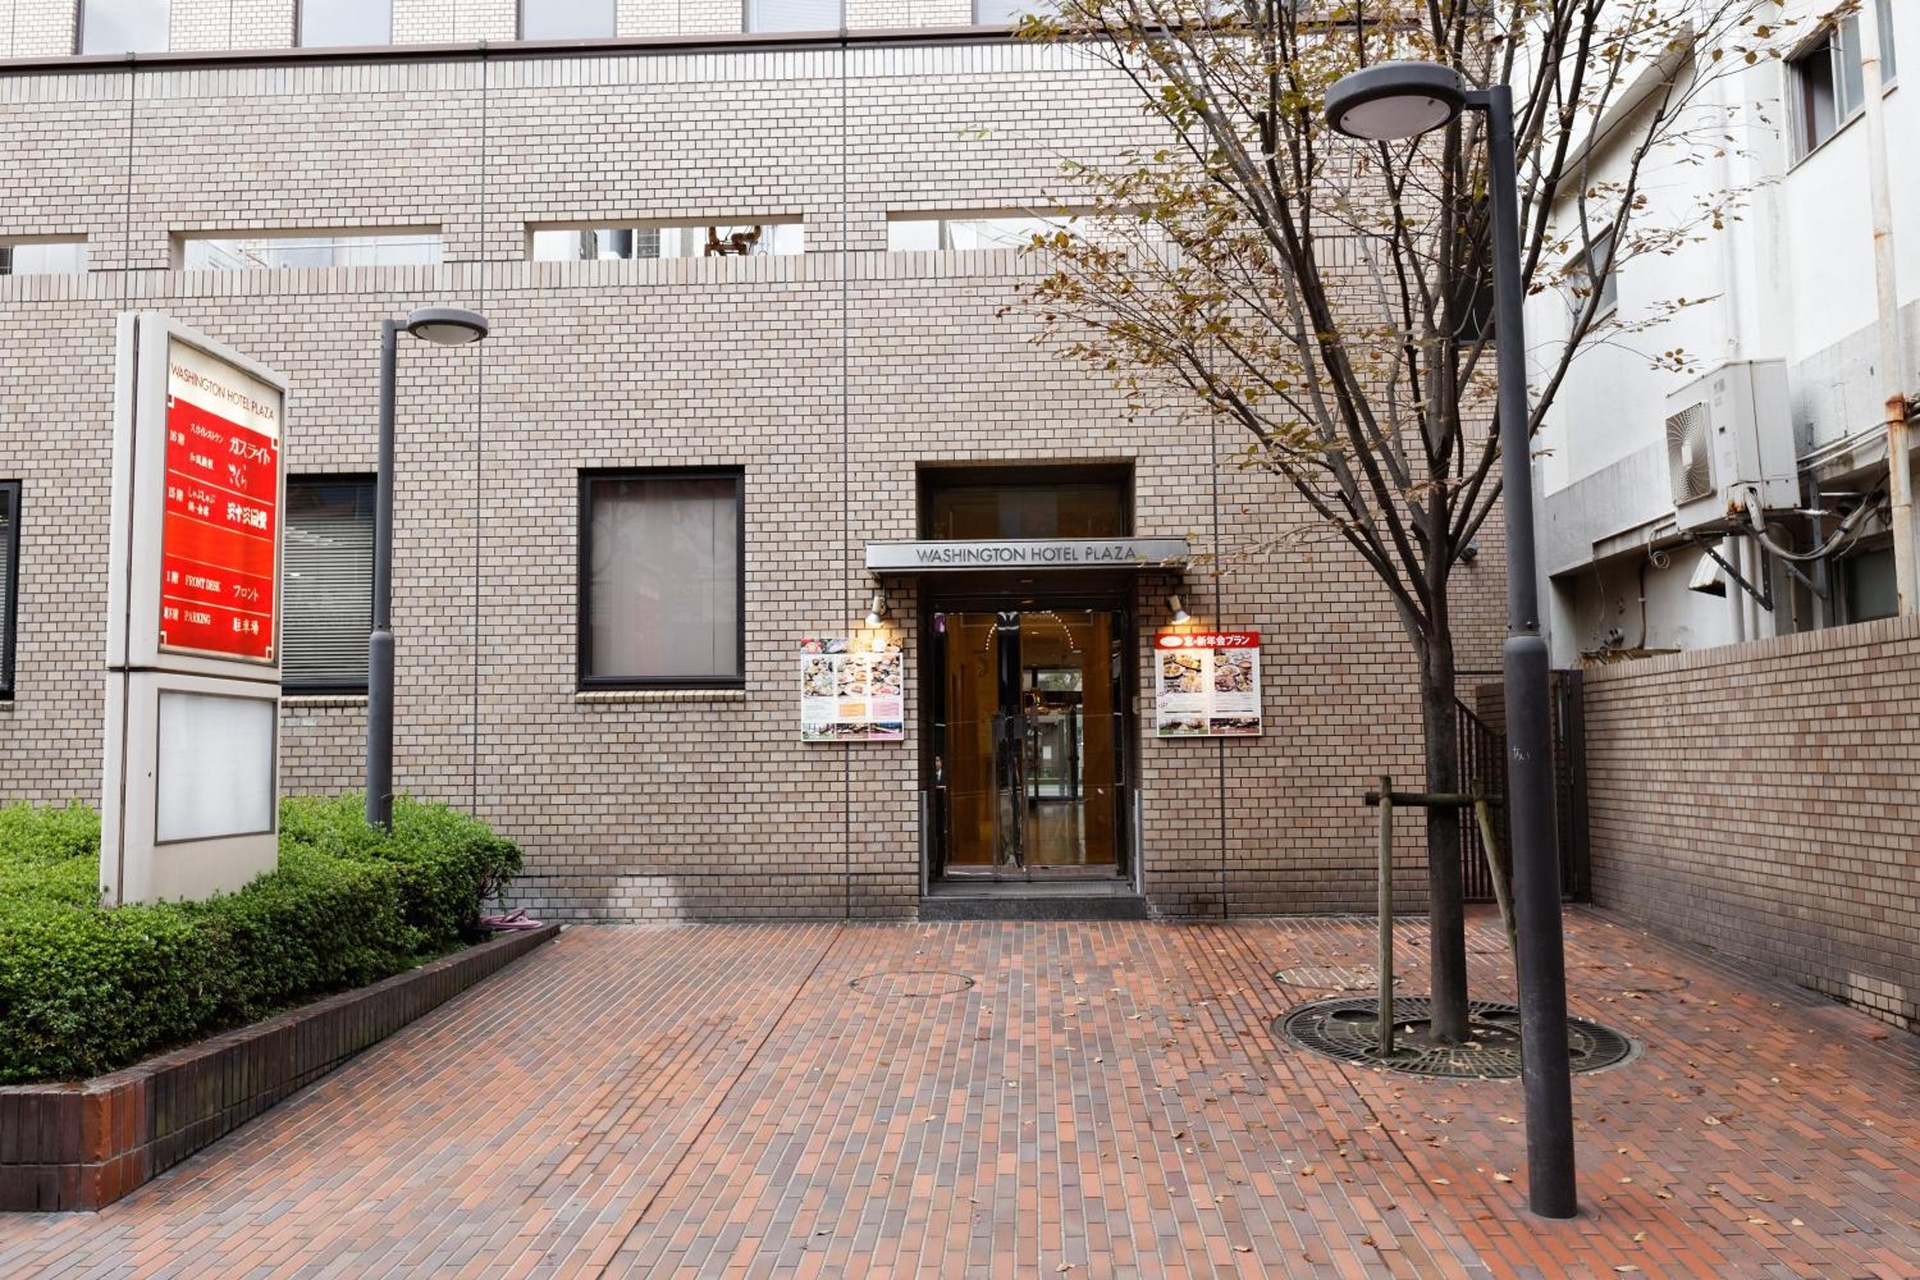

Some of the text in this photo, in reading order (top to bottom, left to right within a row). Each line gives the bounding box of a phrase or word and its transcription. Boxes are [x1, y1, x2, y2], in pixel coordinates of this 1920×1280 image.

[170, 362, 275, 420] WASHINGTON HOTEL PLAZA
[229, 436, 271, 465] ガスライト
[916, 545, 1136, 563] WASHINGTON HOTEL PLAZA
[185, 574, 205, 590] FRONT
[233, 585, 259, 602] フロント
[184, 609, 211, 626] PARKING
